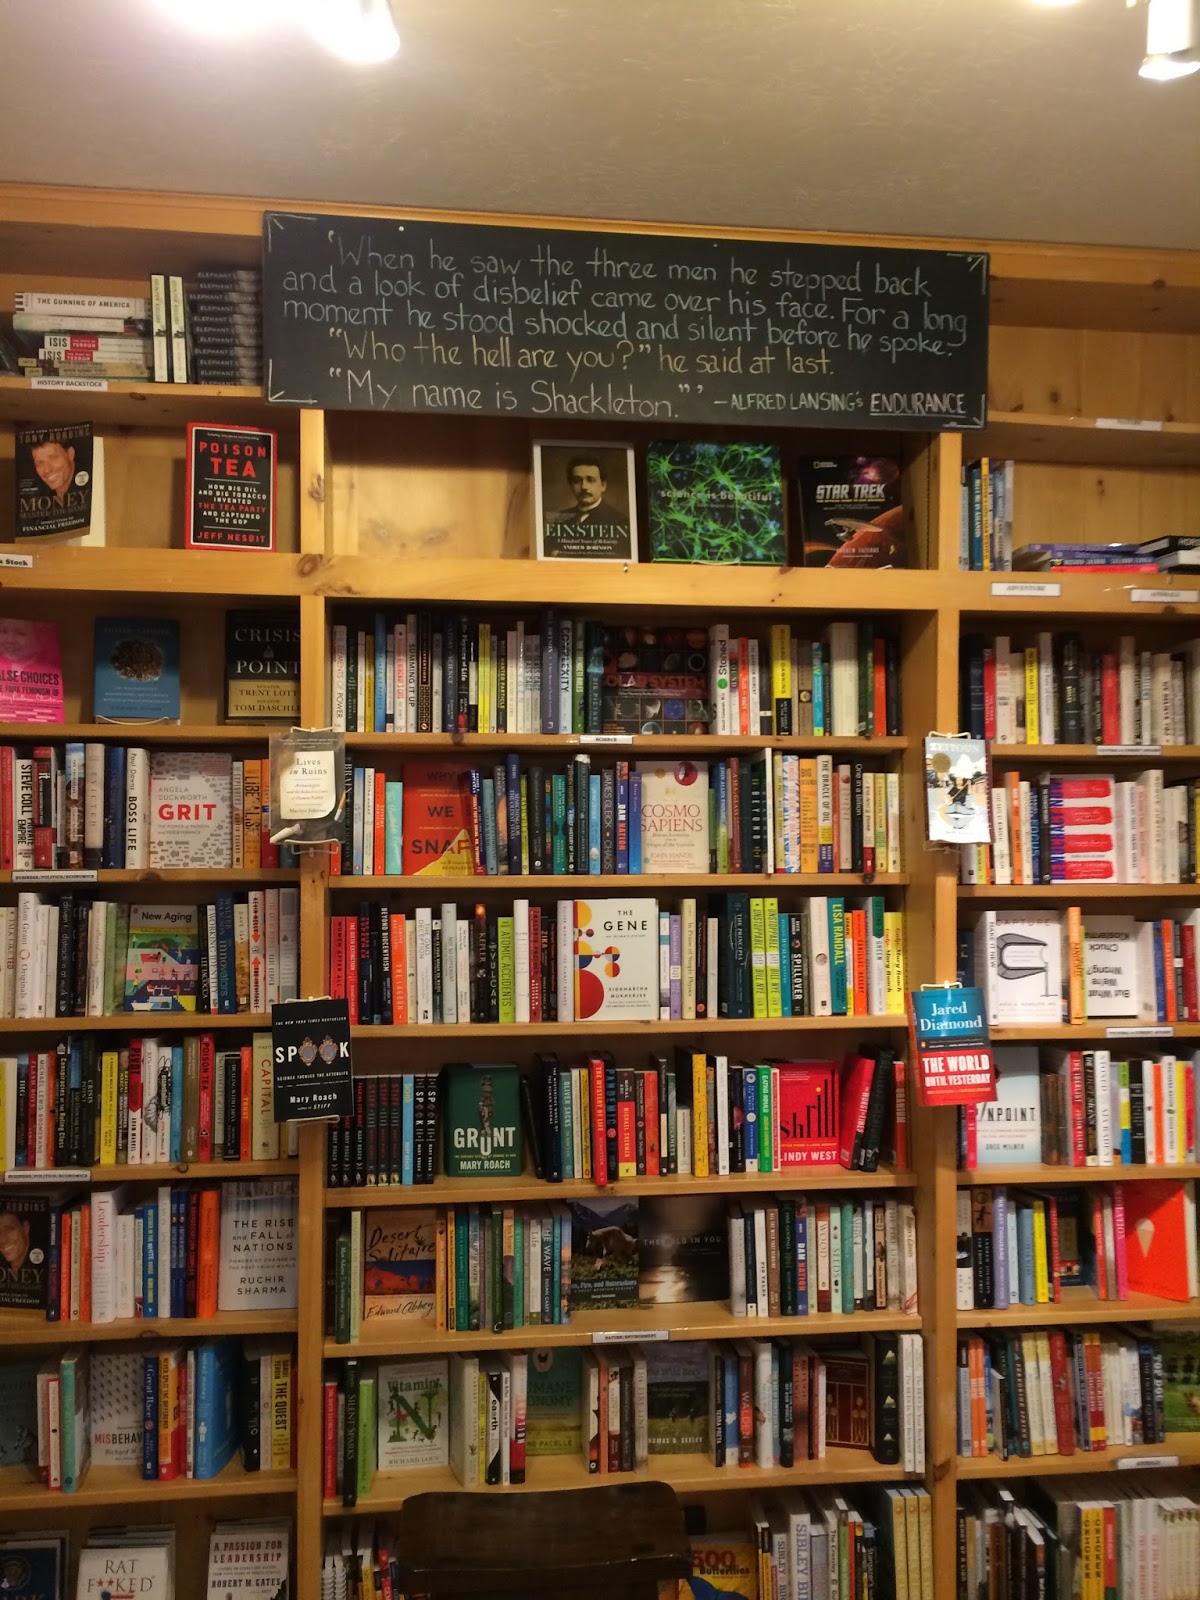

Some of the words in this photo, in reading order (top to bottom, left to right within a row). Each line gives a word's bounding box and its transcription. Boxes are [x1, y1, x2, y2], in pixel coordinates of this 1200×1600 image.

[430, 238, 457, 272] he
[471, 255, 522, 275] saw
[531, 244, 575, 277] the
[586, 247, 657, 281] three
[668, 263, 717, 282] men
[731, 256, 757, 286] he
[769, 259, 861, 301] stepped
[876, 263, 932, 297] back
[283, 265, 337, 294] and
[349, 275, 363, 295] a
[375, 270, 426, 297] look
[435, 272, 464, 298] of
[473, 276, 582, 306] disbelief
[591, 290, 656, 310] came
[664, 293, 721, 312] over
[728, 290, 767, 315] his
[776, 292, 834, 320] face.
[842, 297, 885, 323] For
[892, 310, 910, 330] a
[924, 301, 967, 346] long
[283, 297, 393, 326] moment
[407, 299, 436, 330] he
[443, 303, 514, 336] stood
[525, 309, 627, 340] shocked
[636, 314, 679, 341] and
[688, 315, 758, 342] silent
[767, 311, 841, 348] before
[849, 324, 872, 353] he
[413, 332, 463, 367] the
[473, 335, 511, 368] hell
[518, 350, 558, 369] are
[659, 345, 688, 374] he
[696, 348, 741, 374] said
[749, 347, 775, 374] at
[788, 347, 834, 375] last.
[412, 383, 482, 410] name
[496, 382, 518, 411] is
[870, 393, 966, 414] ENDURANCE
[199, 442, 266, 457] POISON
[211, 457, 256, 477] TEA
[20, 490, 89, 513] MONEY
[815, 484, 850, 500] STAR
[853, 483, 886, 499] TREK
[546, 523, 628, 539] EINSTEIN
[6, 558, 28, 566] Stock
[236, 660, 299, 674] POINT
[408, 643, 416, 684] SUMMING
[560, 626, 570, 693] COMPLEXITY
[718, 639, 728, 676] Stoned
[20, 670, 60, 686] CHOICES
[408, 686, 415, 694] IT
[408, 696, 415, 708] UP
[129, 753, 137, 767] Paul
[21, 764, 33, 791] STEVE
[129, 769, 137, 791] Downs
[604, 772, 613, 798] JAMES
[21, 793, 33, 816] COLL
[127, 796, 138, 824] BOSS
[158, 803, 217, 821] GRIT
[427, 806, 454, 818] WE
[604, 799, 613, 828] GLEICK
[641, 804, 701, 818] COSMO
[17, 819, 26, 845] EMPIRE
[641, 819, 703, 832] SAPIENS
[127, 828, 137, 851] LIFE
[604, 839, 613, 870] CHAOS
[21, 898, 30, 921] Adam
[141, 911, 162, 921] New
[164, 911, 192, 923] Aging
[380, 907, 388, 931] BEYOND
[832, 903, 842, 924] LISA
[21, 923, 30, 945] Grant
[603, 919, 648, 932] GENE
[753, 909, 763, 949] UNSTOPPABLE
[381, 932, 389, 972] BIOCENTRISM
[501, 931, 512, 960] ATOMIC
[833, 925, 844, 965] RANDALL
[1088, 944, 1119, 952] Chuck
[755, 968, 765, 981] BILL
[793, 953, 803, 1000] SPILLOVER
[1086, 965, 1123, 975] Wrong?
[19, 963, 29, 999] Originals
[502, 963, 512, 1007] ACCIDENTS
[756, 982, 765, 994] NYE
[1088, 990, 1112, 998] What
[1114, 989, 1130, 998] But
[931, 1001, 968, 1017] Jared
[919, 1015, 983, 1032] Diamond
[922, 1056, 945, 1074] THE
[946, 1054, 990, 1072] WORLD
[261, 1059, 272, 1115] CAPITAL
[925, 1075, 947, 1087] UNTIL
[948, 1073, 991, 1085] YESTERDAY
[313, 1093, 337, 1101] Roach
[563, 1081, 571, 1104] OLIVER
[606, 1068, 616, 1125] PANDEMIC
[563, 1106, 571, 1128] SACKS
[453, 1127, 516, 1156] GRUNT
[460, 1161, 482, 1170] MARY
[484, 1159, 511, 1169] ROACH
[780, 1151, 808, 1162] LINDY
[811, 1150, 837, 1160] WEST
[94, 1200, 109, 1263] Leadership
[233, 1220, 261, 1229] THE
[265, 1218, 295, 1228] RISE
[250, 1232, 283, 1240] FALL
[286, 1232, 294, 1240] of
[369, 1225, 434, 1246] Desert
[819, 1223, 829, 1259] WOOD
[233, 1243, 294, 1252] NATIONS
[797, 1242, 806, 1261] DAM
[543, 1245, 552, 1272] WAVE
[832, 1247, 841, 1278] SEEDS
[240, 1276, 284, 1285] RUCHIR
[797, 1262, 806, 1292] NATION
[236, 1286, 287, 1295] SHARMA
[366, 1303, 401, 1319] Edward
[402, 1300, 434, 1318] Abbey
[145, 1369, 154, 1394] Great
[275, 1382, 287, 1399] THE
[145, 1396, 154, 1418] Race
[275, 1401, 287, 1430] QUEST
[741, 1391, 750, 1440] WALDEN
[94, 1432, 144, 1444] MISBEHAV
[214, 1543, 220, 1552] A
[224, 1542, 262, 1551] PASSION
[265, 1540, 283, 1550] FOR
[796, 1524, 809, 1575] SIBLEY
[104, 1559, 138, 1574] RAT
[213, 1552, 282, 1564] LEADERSHIP
[700, 1566, 750, 1576] Butterflies
